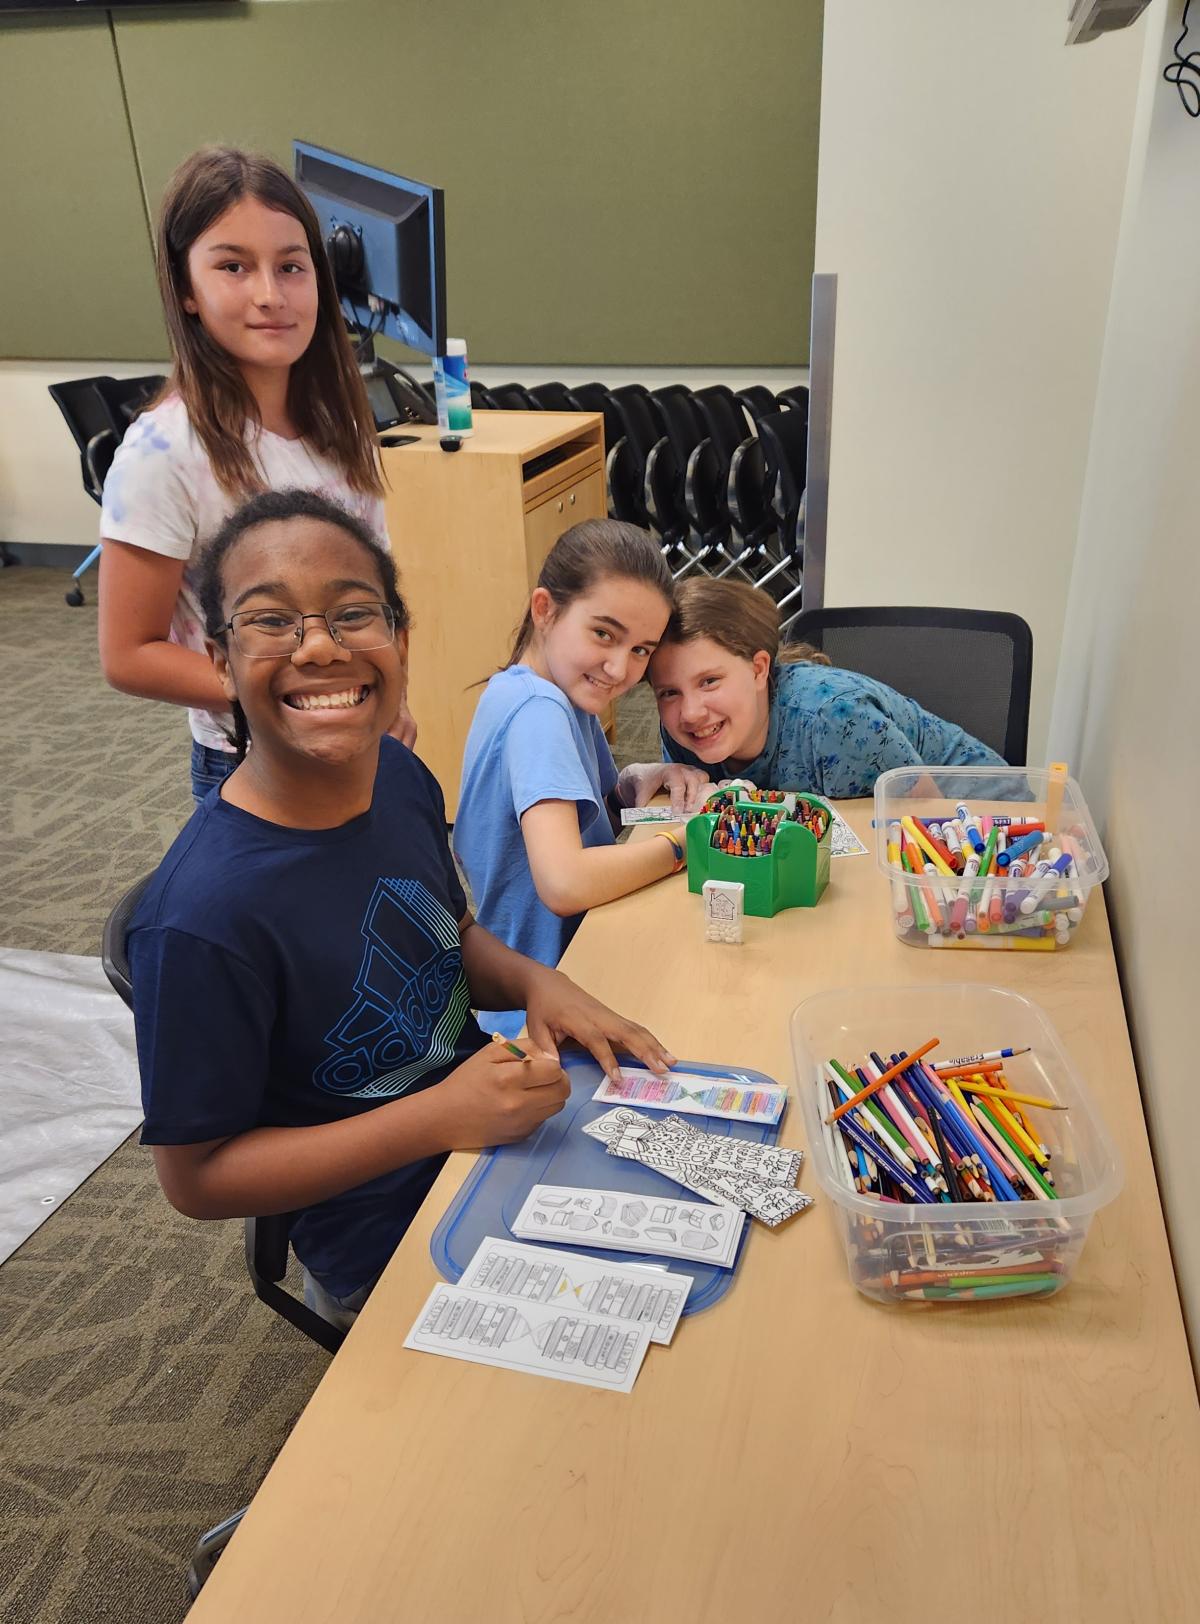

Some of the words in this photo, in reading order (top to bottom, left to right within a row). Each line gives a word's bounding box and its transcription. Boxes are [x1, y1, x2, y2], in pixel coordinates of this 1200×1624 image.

[318, 950, 462, 1090] adidas
[691, 1139, 714, 1163] READ
[702, 1146, 722, 1166] mean
[718, 1143, 736, 1166] PARTY
[742, 1147, 765, 1177] PARTY!
[768, 1158, 790, 1178] like
